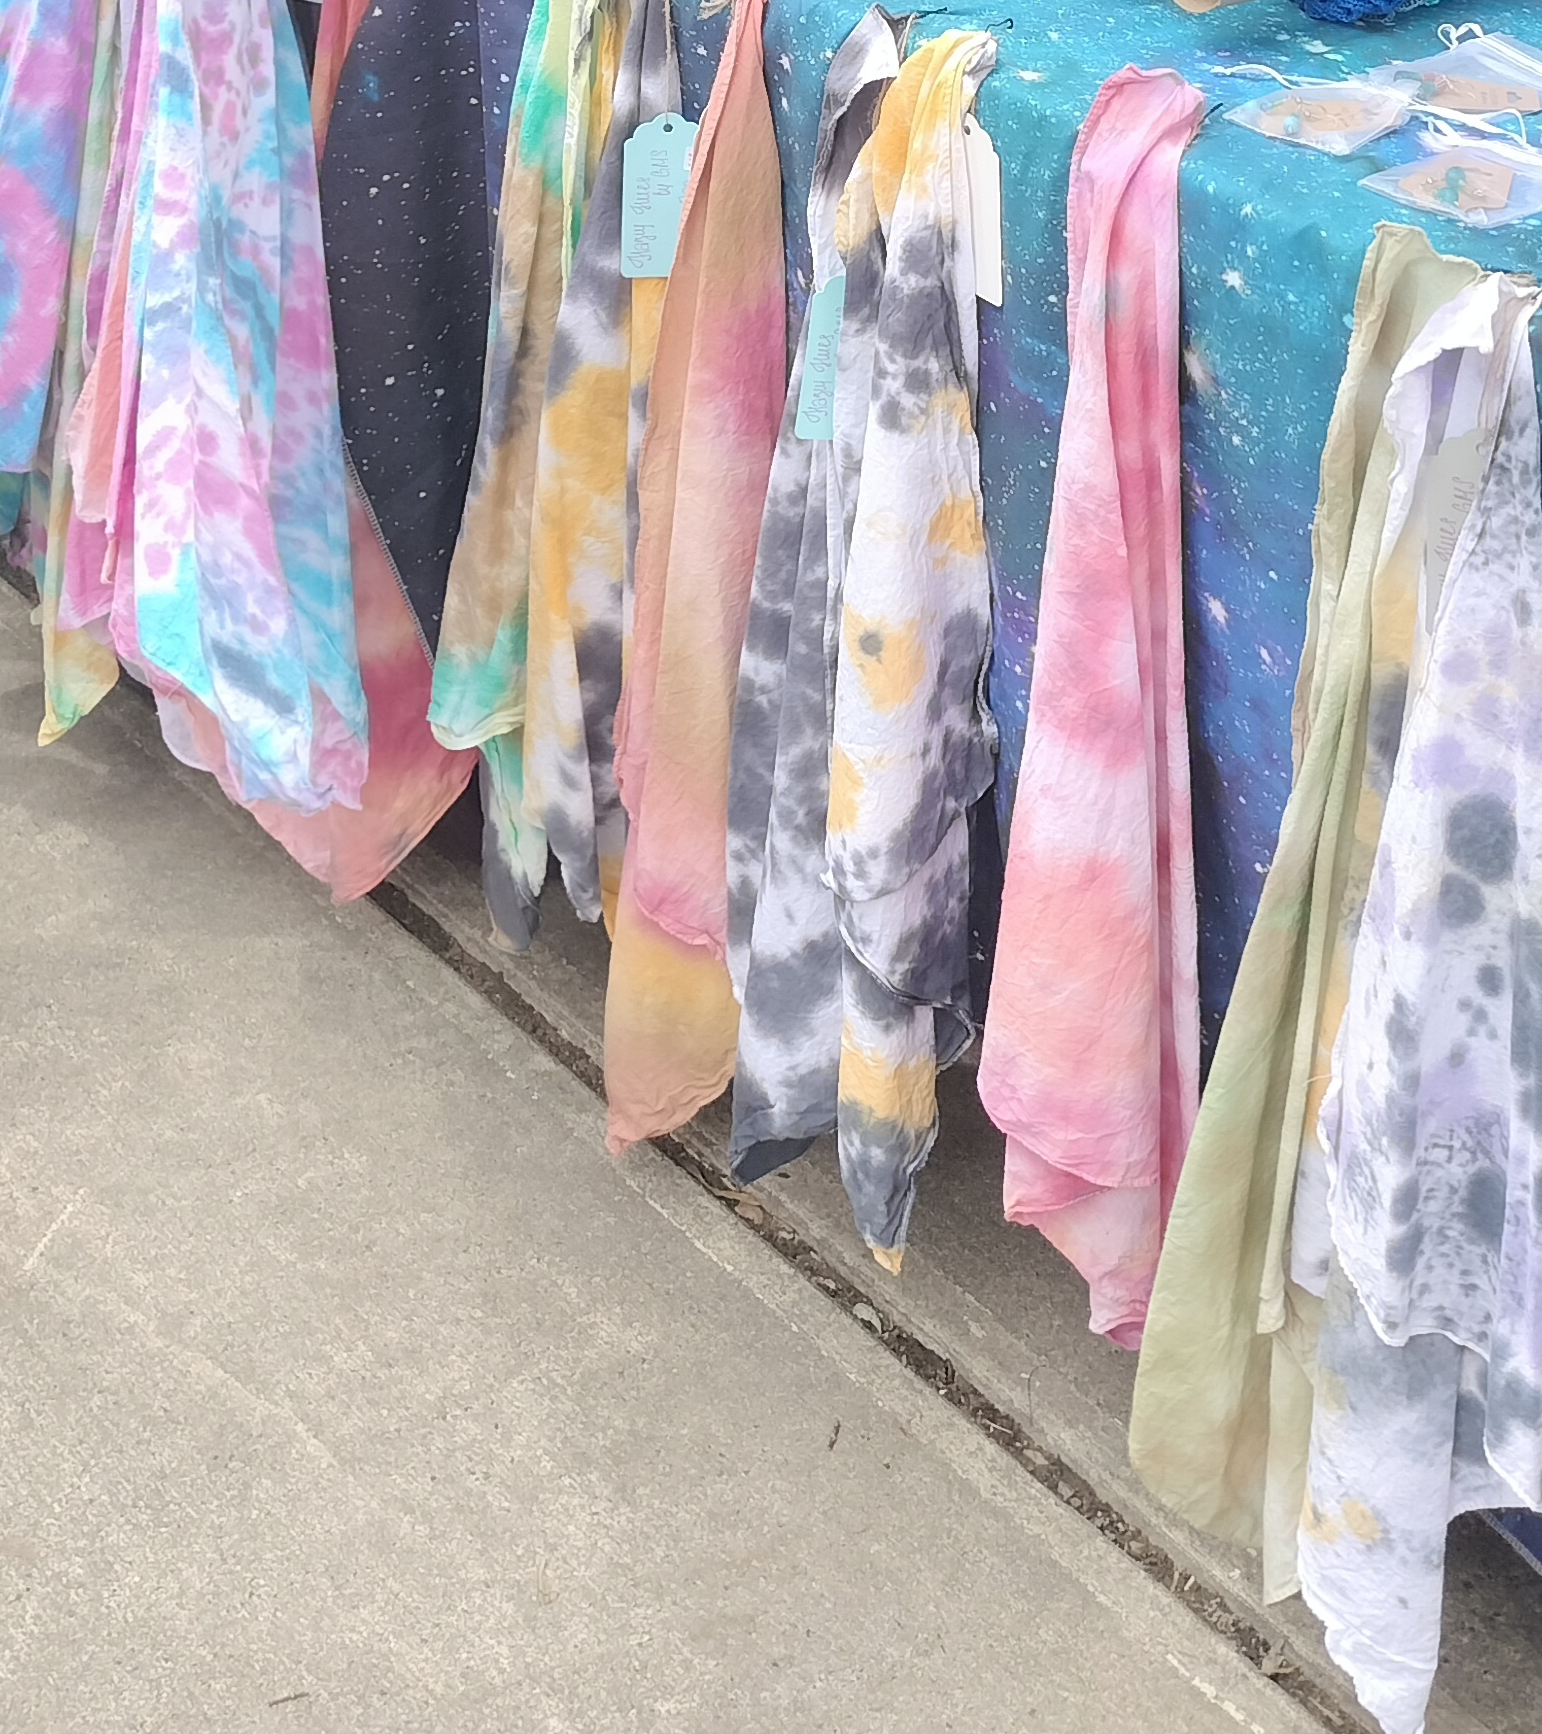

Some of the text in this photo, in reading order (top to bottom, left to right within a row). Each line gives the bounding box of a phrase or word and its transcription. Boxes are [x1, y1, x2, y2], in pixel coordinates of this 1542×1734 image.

[626, 176, 658, 270] Hazy Hues
[652, 183, 674, 197] by
[801, 333, 835, 425] Hazy Hues
